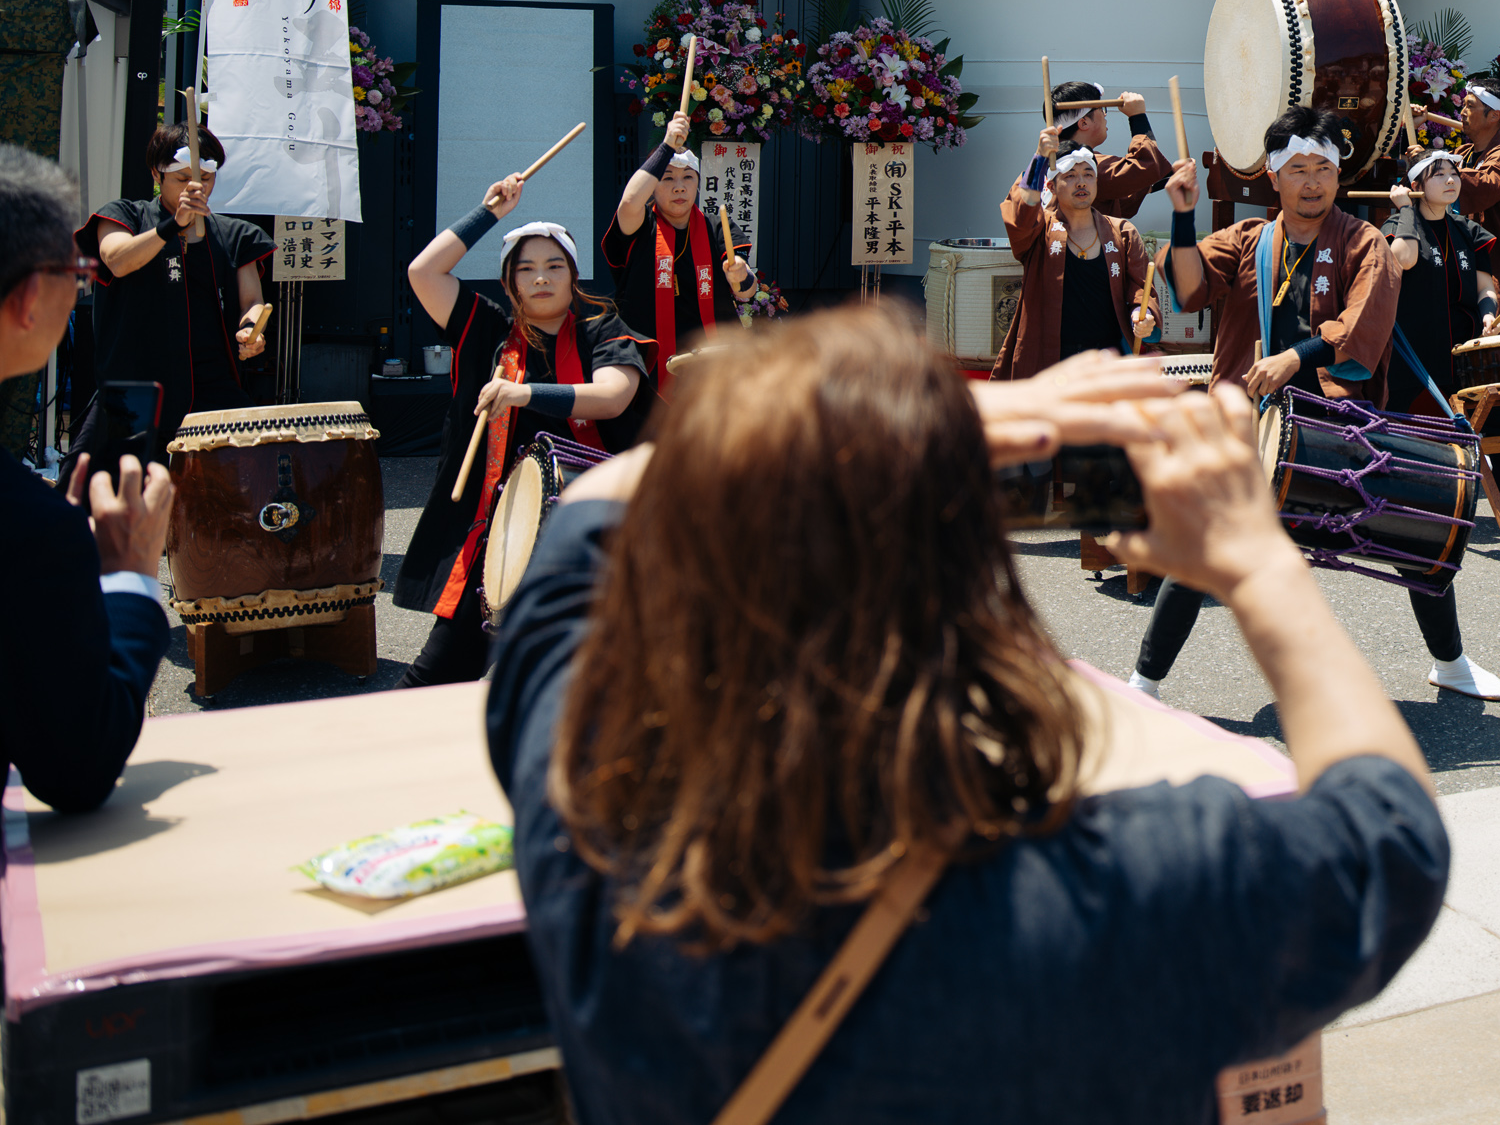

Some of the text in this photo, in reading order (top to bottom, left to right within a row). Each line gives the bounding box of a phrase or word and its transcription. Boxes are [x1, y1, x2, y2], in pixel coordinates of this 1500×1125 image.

[282, 16, 296, 152] Yokoyama Goju
[703, 176, 720, 216] 日高
[724, 167, 736, 220] 代表取締
[658, 258, 671, 287] 風舞
[699, 267, 711, 296] 風舞
[1314, 247, 1334, 296] 風舞
